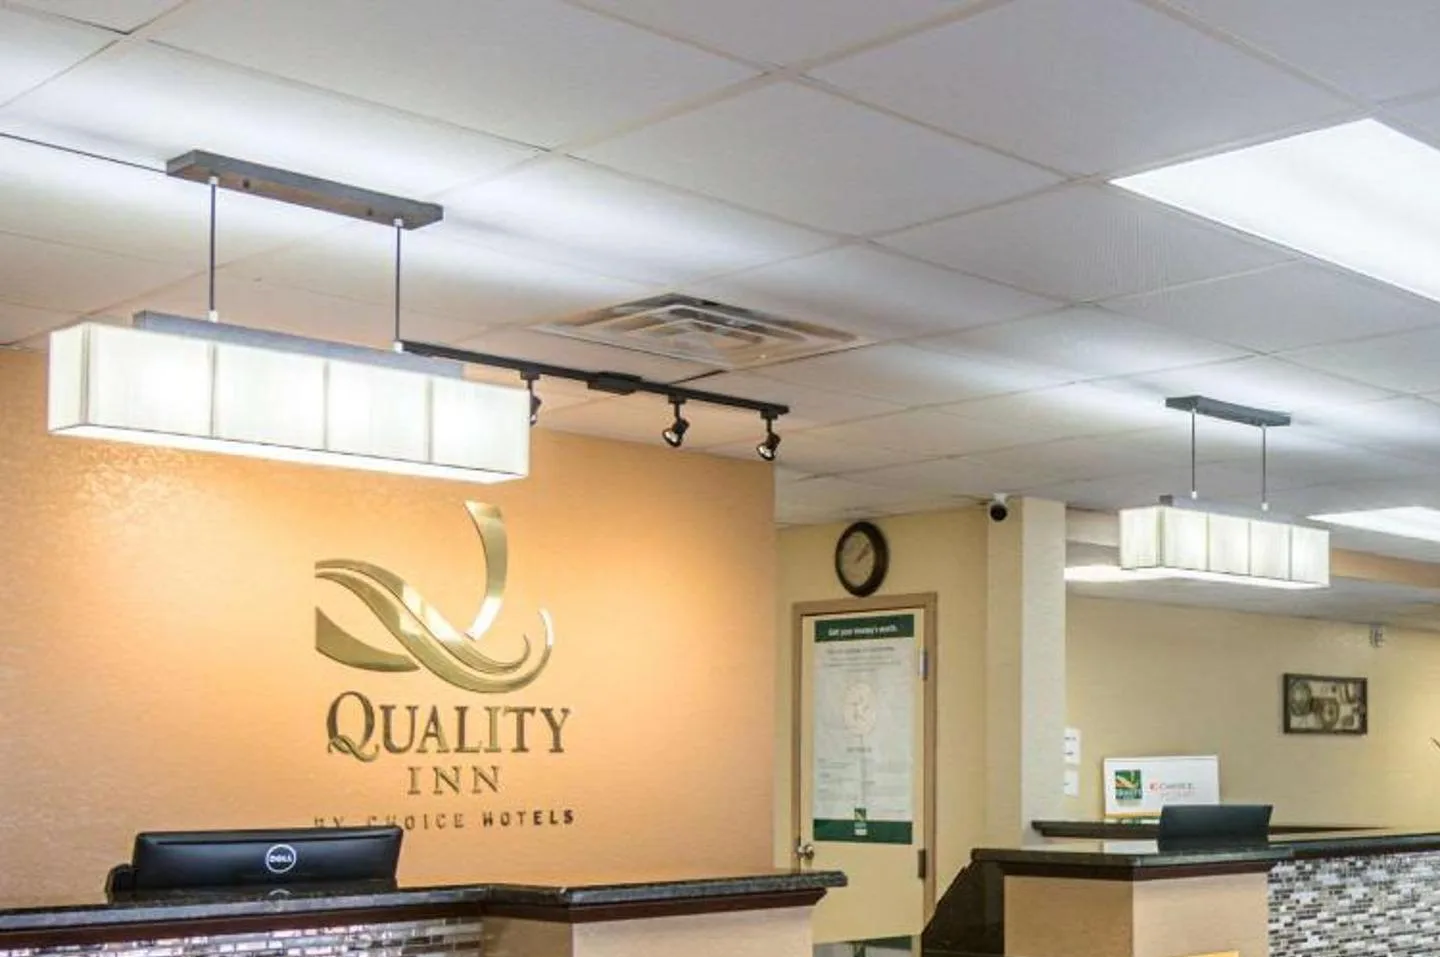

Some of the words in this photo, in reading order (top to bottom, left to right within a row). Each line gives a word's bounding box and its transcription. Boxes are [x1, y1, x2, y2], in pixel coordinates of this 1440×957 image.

[326, 691, 571, 762] QUALITY
[407, 765, 501, 795] INN
[482, 809, 574, 827] HOTELS
